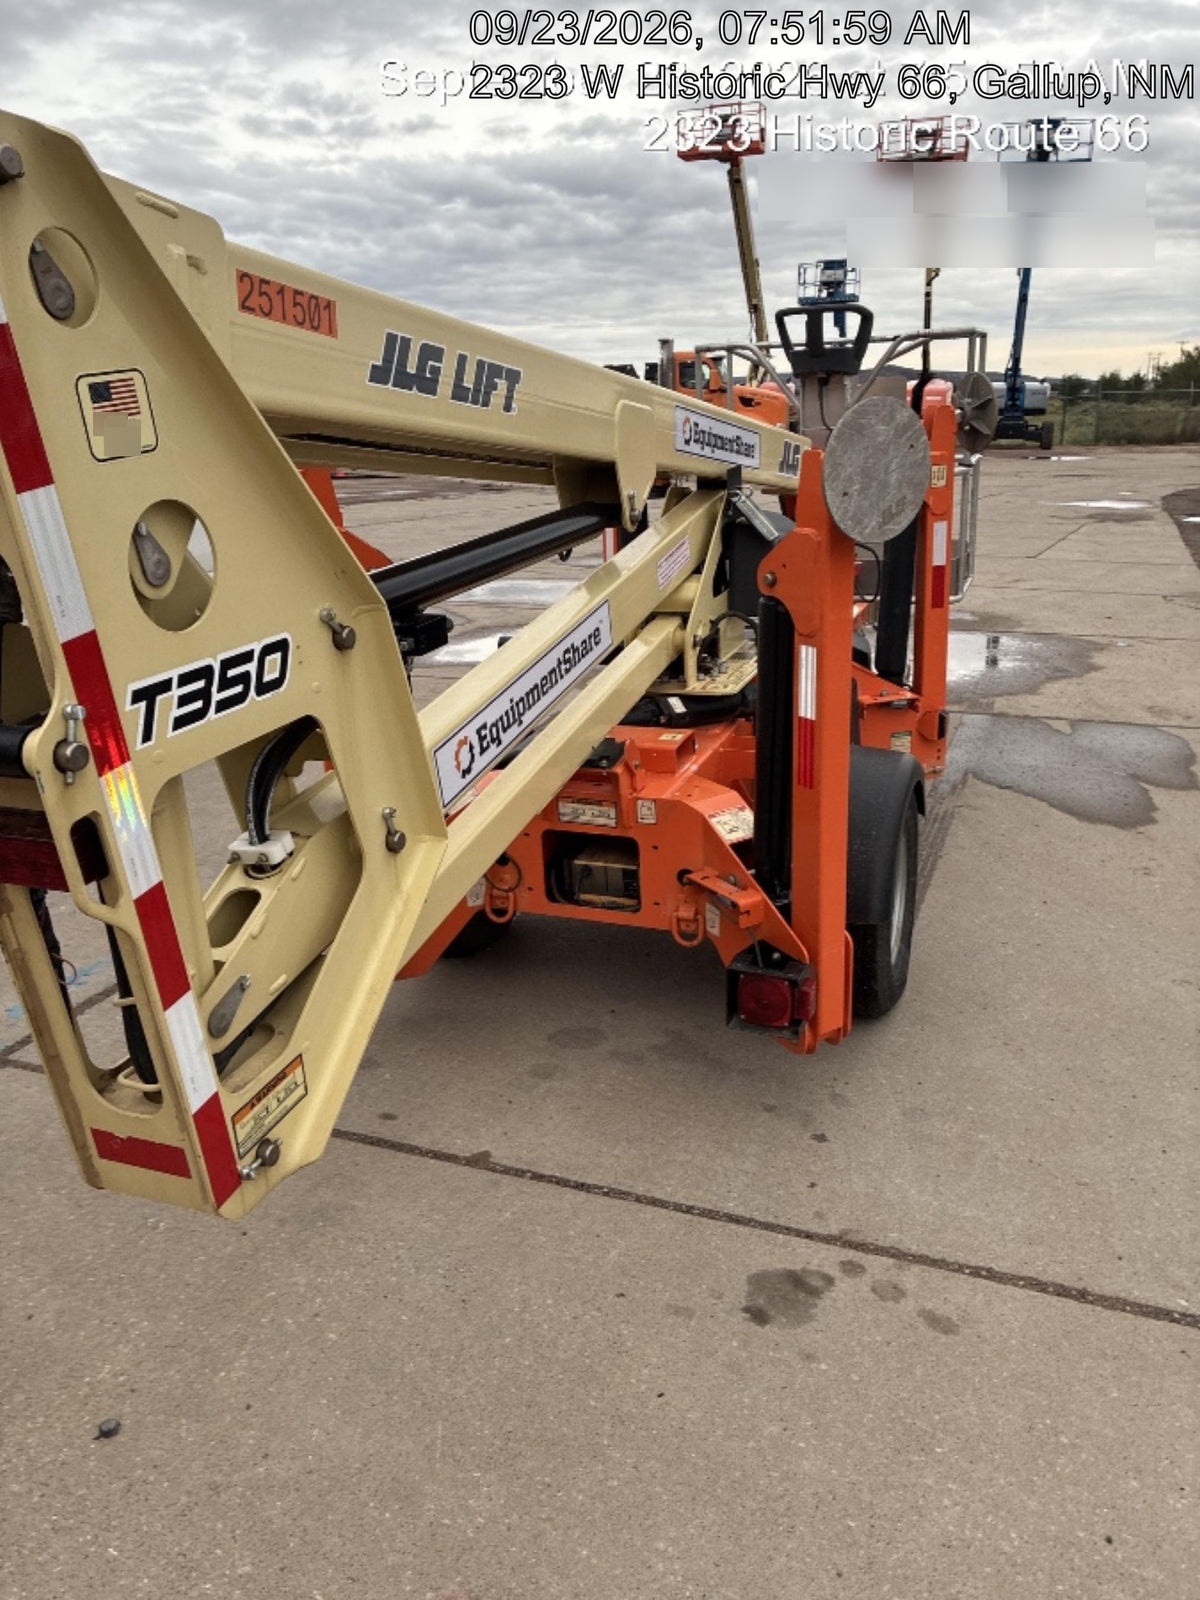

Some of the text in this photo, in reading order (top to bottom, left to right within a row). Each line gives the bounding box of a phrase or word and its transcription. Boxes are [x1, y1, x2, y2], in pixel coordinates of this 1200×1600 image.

[238, 271, 335, 336] 251501
[366, 329, 523, 416] JLG LIFT
[692, 421, 756, 460] EquipmentShare
[127, 632, 292, 751] T350
[475, 625, 604, 757] EquipmentShare
